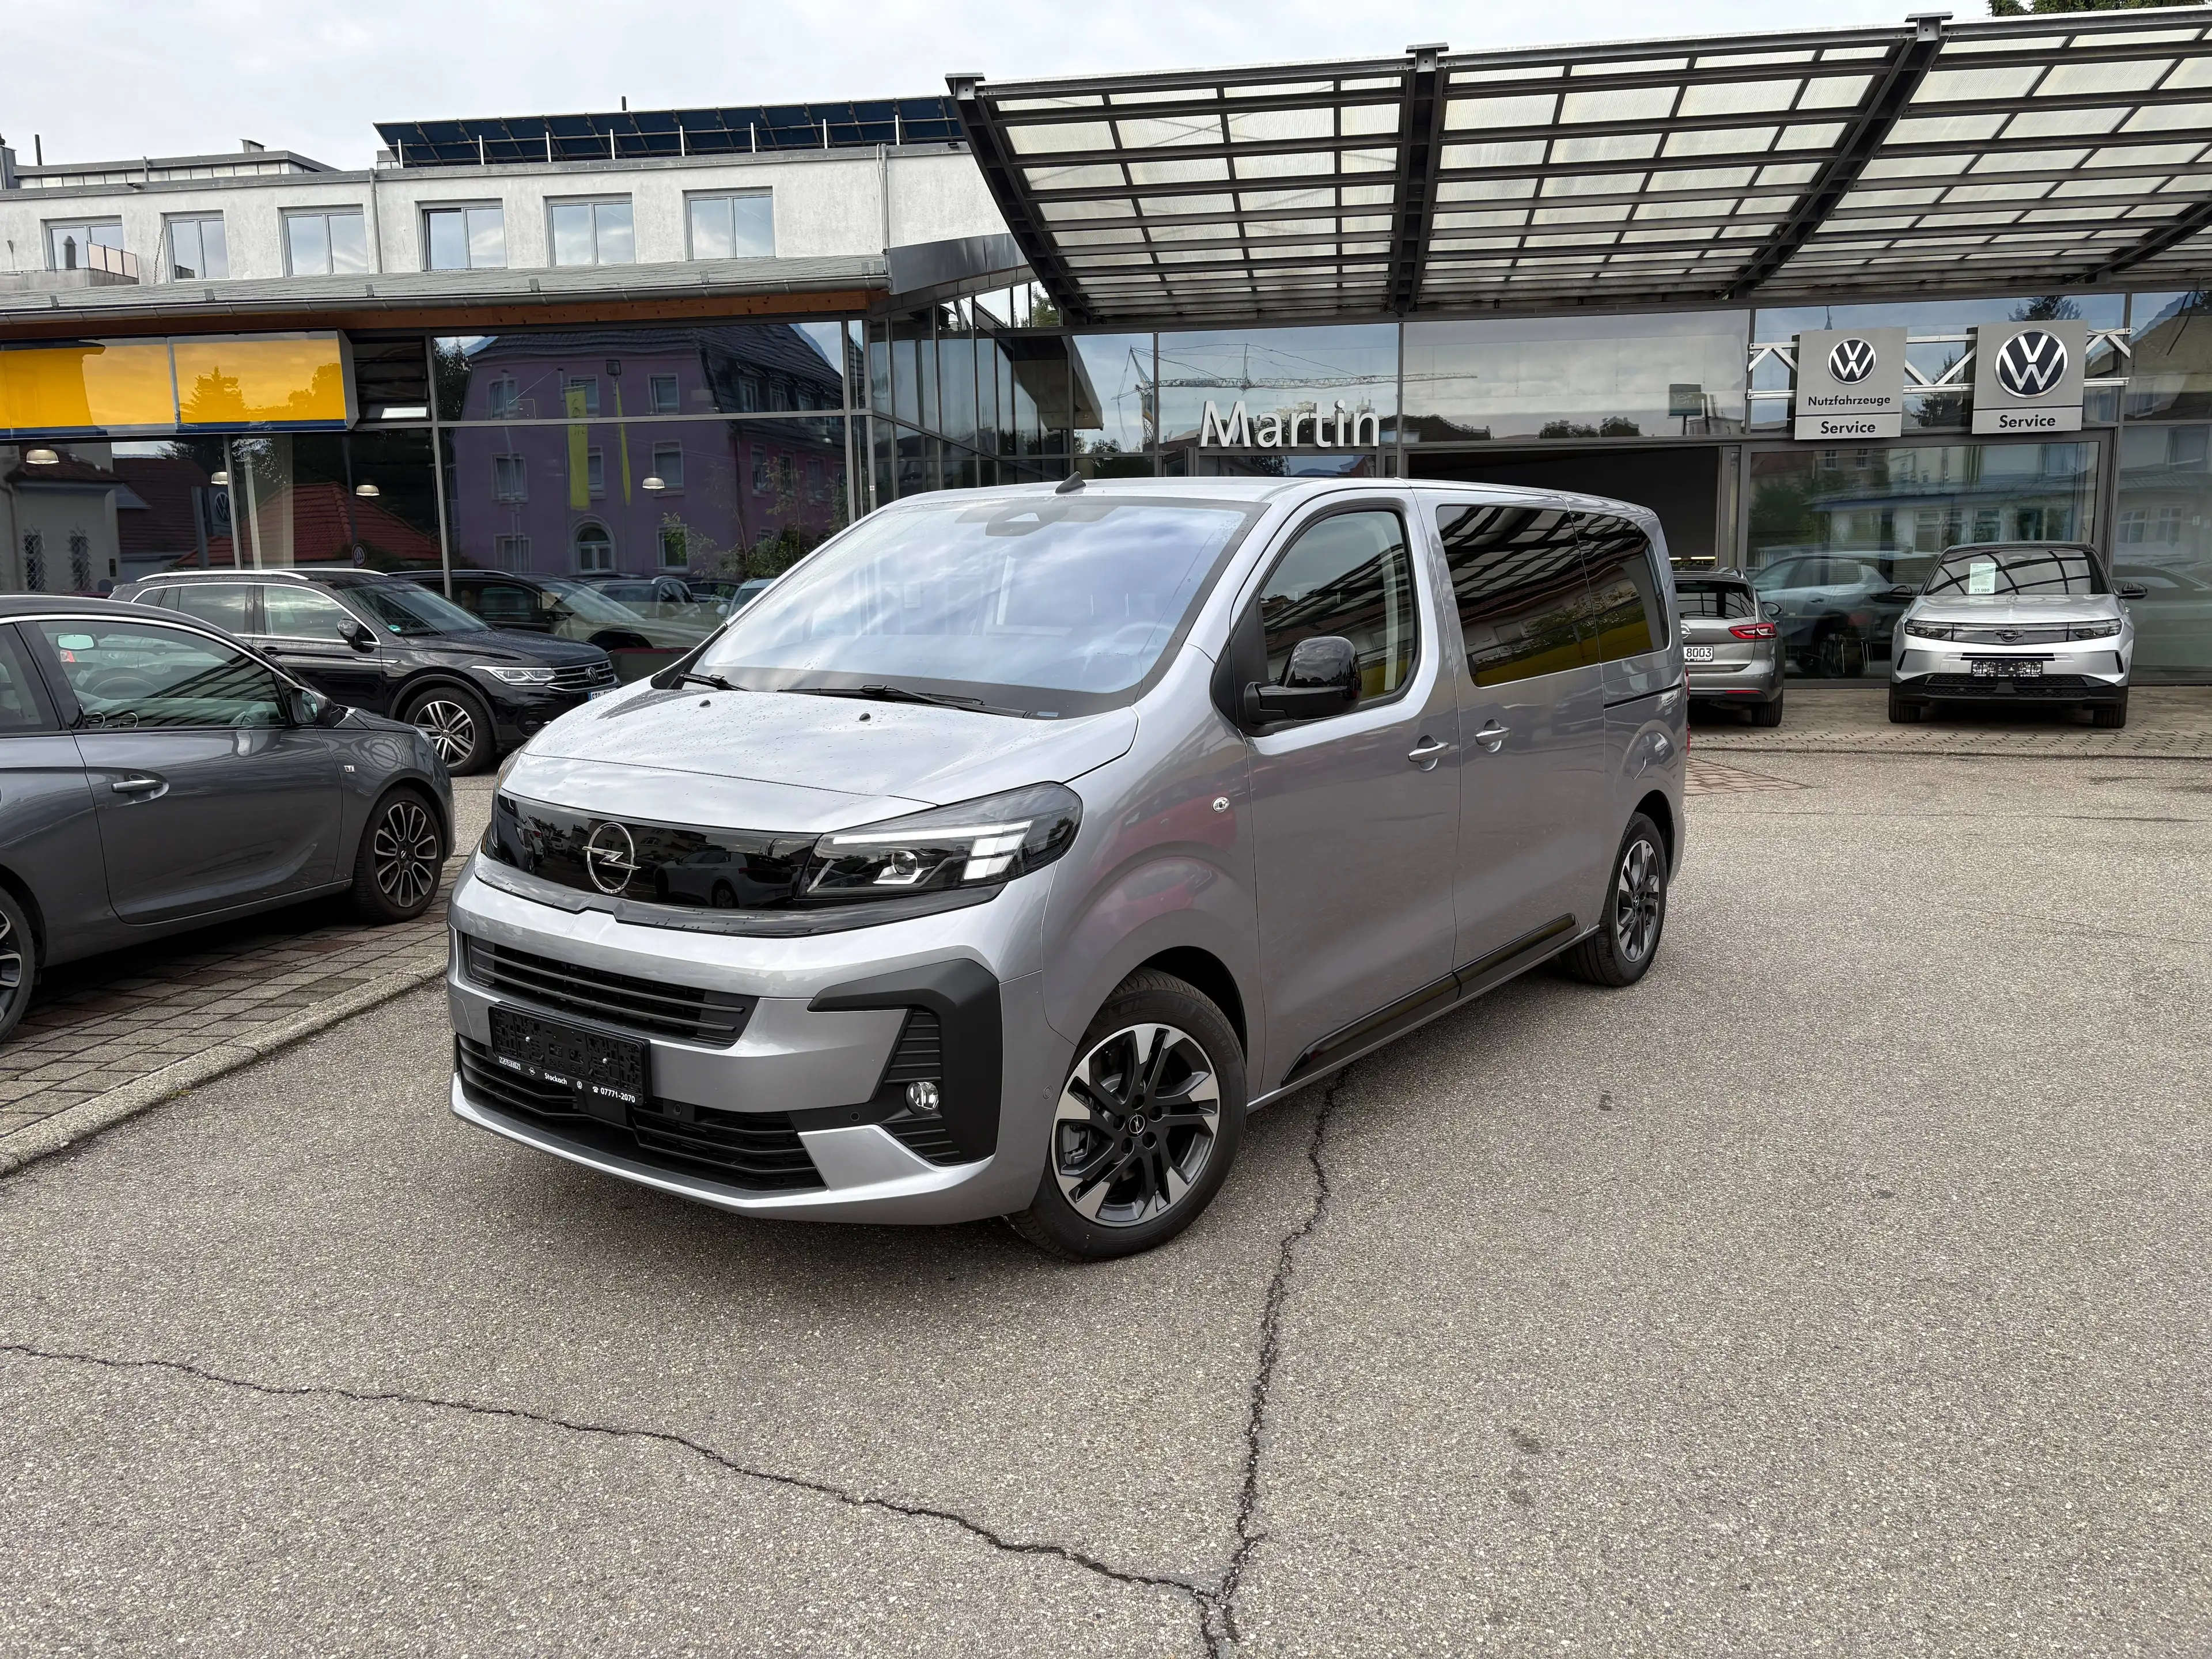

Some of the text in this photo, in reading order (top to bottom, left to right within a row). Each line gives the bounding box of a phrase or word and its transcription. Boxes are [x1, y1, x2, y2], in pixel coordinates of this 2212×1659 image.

[1808, 395, 1891, 406] Nutzfahrzeuge
[1200, 399, 1380, 448] Martin
[1820, 421, 1876, 434] Service
[1999, 414, 2056, 428] Service
[1686, 648, 1712, 657] 8003
[499, 1056, 521, 1071] MARTIN
[544, 1072, 567, 1085] Stockach
[600, 1087, 635, 1103] 07771-2070
